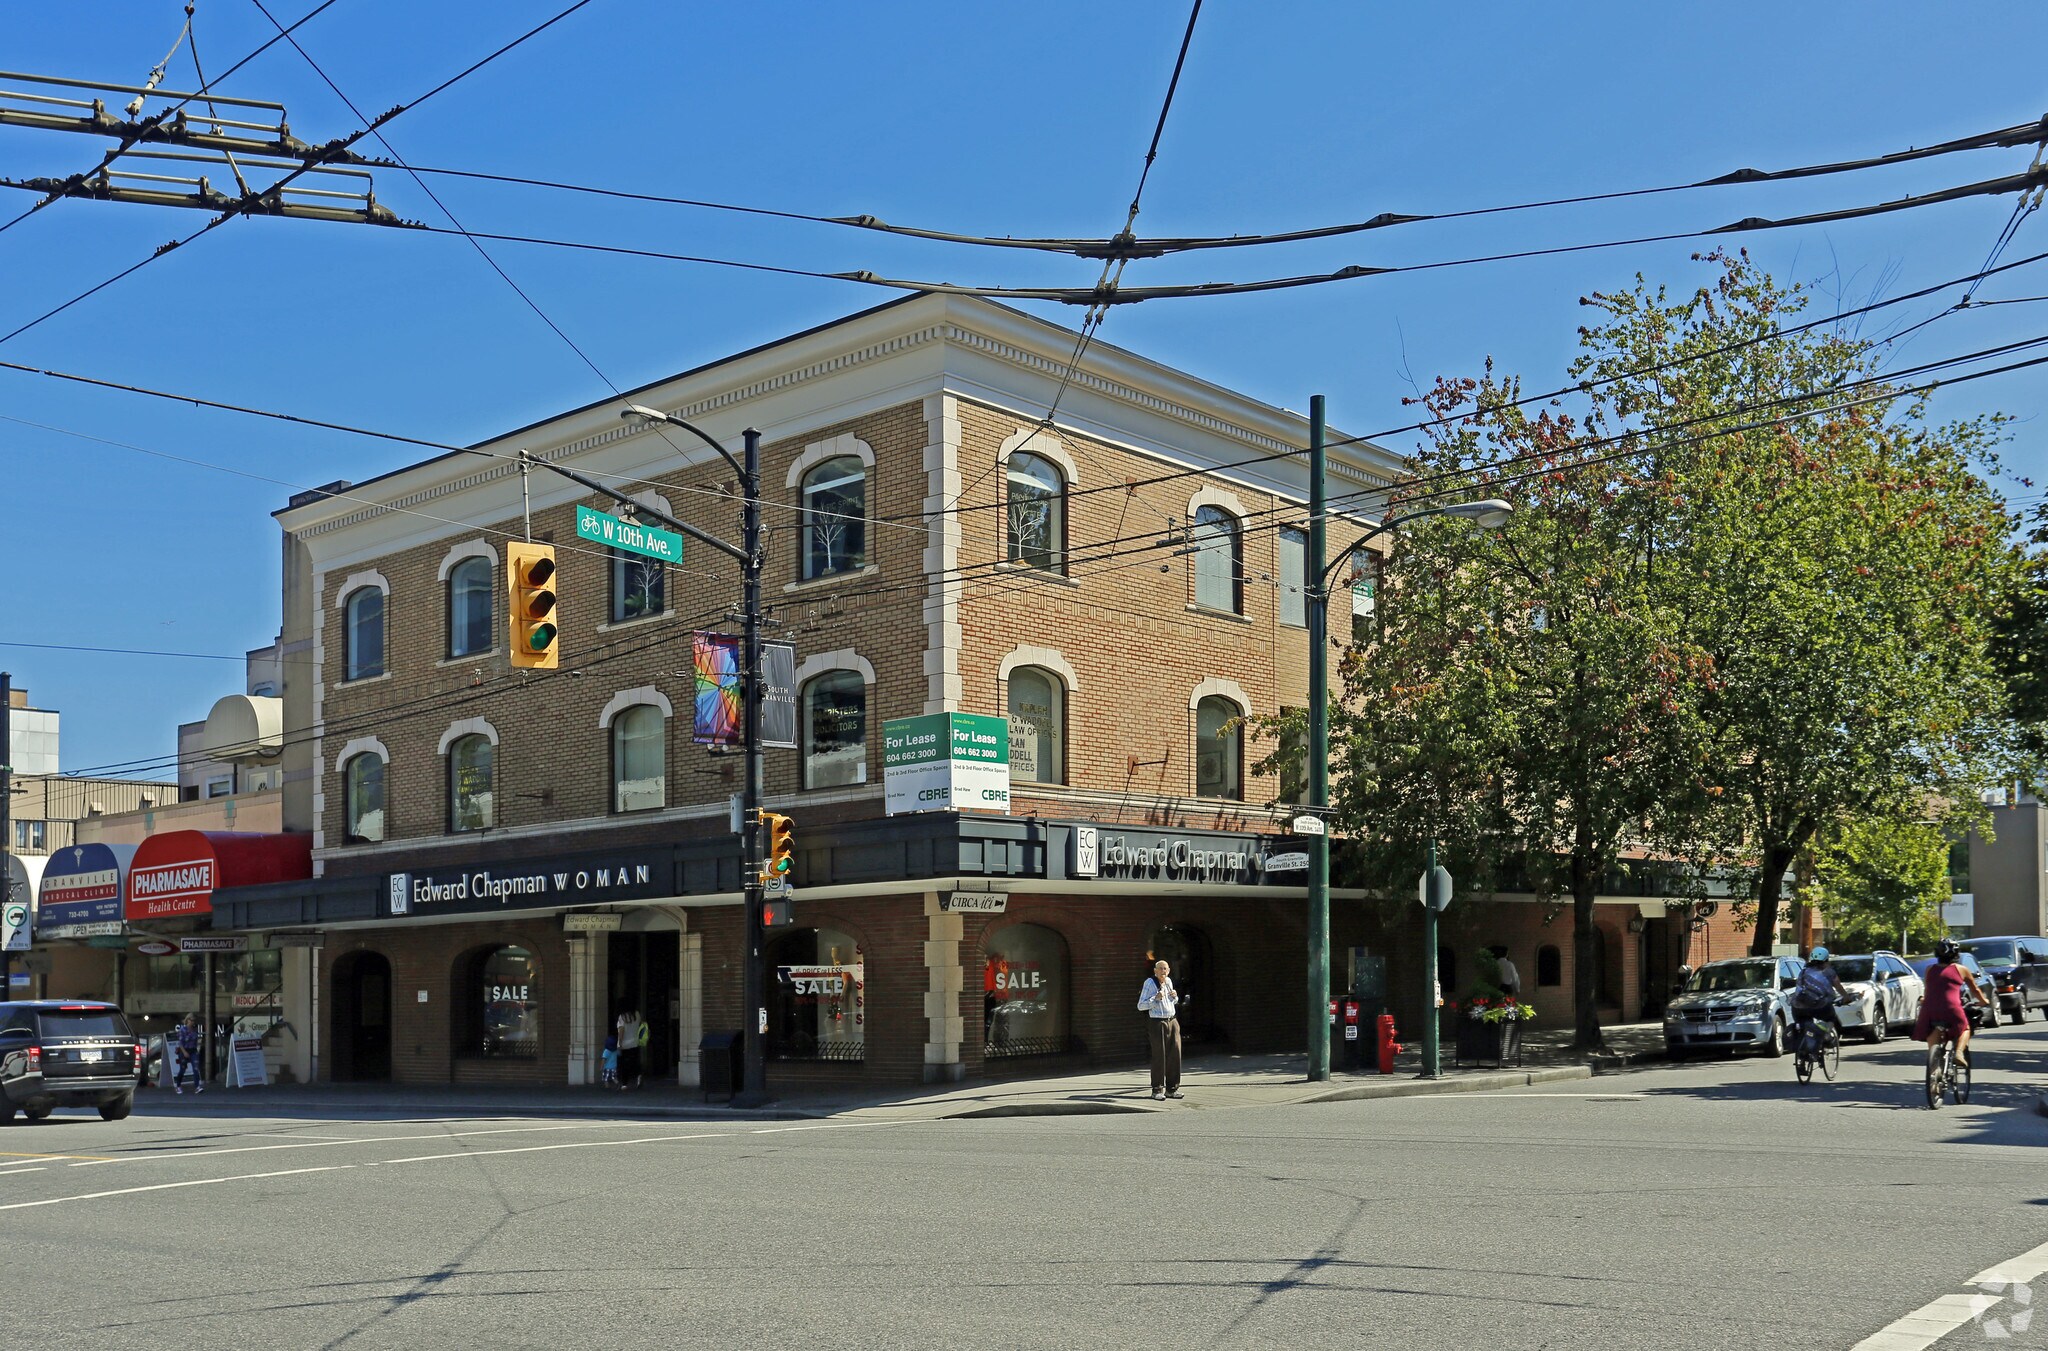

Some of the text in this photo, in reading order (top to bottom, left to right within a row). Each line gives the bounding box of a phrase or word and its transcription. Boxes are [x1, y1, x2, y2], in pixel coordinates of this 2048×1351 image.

[603, 520, 671, 556] W 10th Ave.
[767, 686, 789, 694] SOUTH
[814, 720, 858, 734] SOLICITORS
[1010, 725, 1025, 736] LAW
[886, 733, 936, 748] For Lease
[954, 728, 997, 744] For Lease
[886, 748, 936, 762] 604 662 3000
[954, 746, 998, 758] 604 662 3000
[920, 766, 932, 774] Office
[933, 764, 948, 772] Spaces
[918, 788, 948, 802] CBRE
[982, 790, 1008, 802] CBRE
[1080, 830, 1094, 849] EC
[1080, 850, 1094, 869] W
[1104, 836, 1168, 867] Edward
[1171, 840, 1247, 876] Chapman
[1268, 862, 1290, 870] Granville
[44, 872, 114, 888] GRANVILLE
[135, 866, 210, 894] PHARMASAVE
[392, 876, 404, 893] EC
[414, 865, 650, 903] Edward Chapman WOMAN
[44, 886, 114, 902] MEDICAL CLINIC
[148, 899, 196, 914] Health Centre
[392, 894, 404, 910] W
[951, 896, 978, 908] CIRCA
[566, 914, 619, 924] Edward Chapman
[183, 940, 233, 949] PHARMASAVE
[795, 978, 843, 995] SALE
[996, 971, 1040, 990] SALE
[236, 994, 276, 1005] MEDICAL CLINC
[492, 986, 528, 1000] SALE
[252, 1022, 268, 1031] Green
